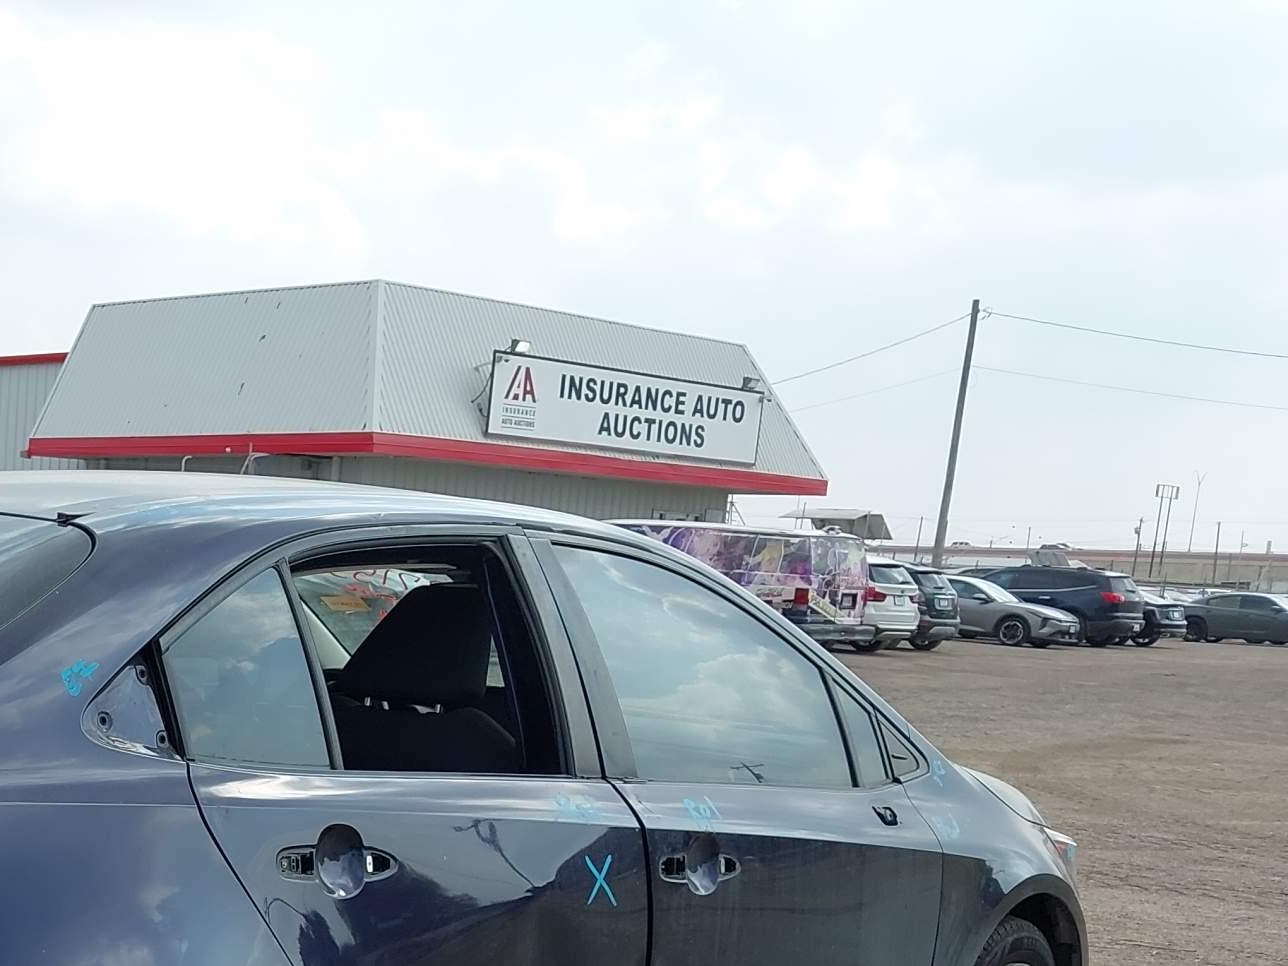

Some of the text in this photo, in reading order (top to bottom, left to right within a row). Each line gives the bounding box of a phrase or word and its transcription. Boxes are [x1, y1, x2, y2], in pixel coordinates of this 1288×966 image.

[559, 373, 746, 424] INSURANCE AUTO
[597, 411, 706, 449] AUCTIONS
